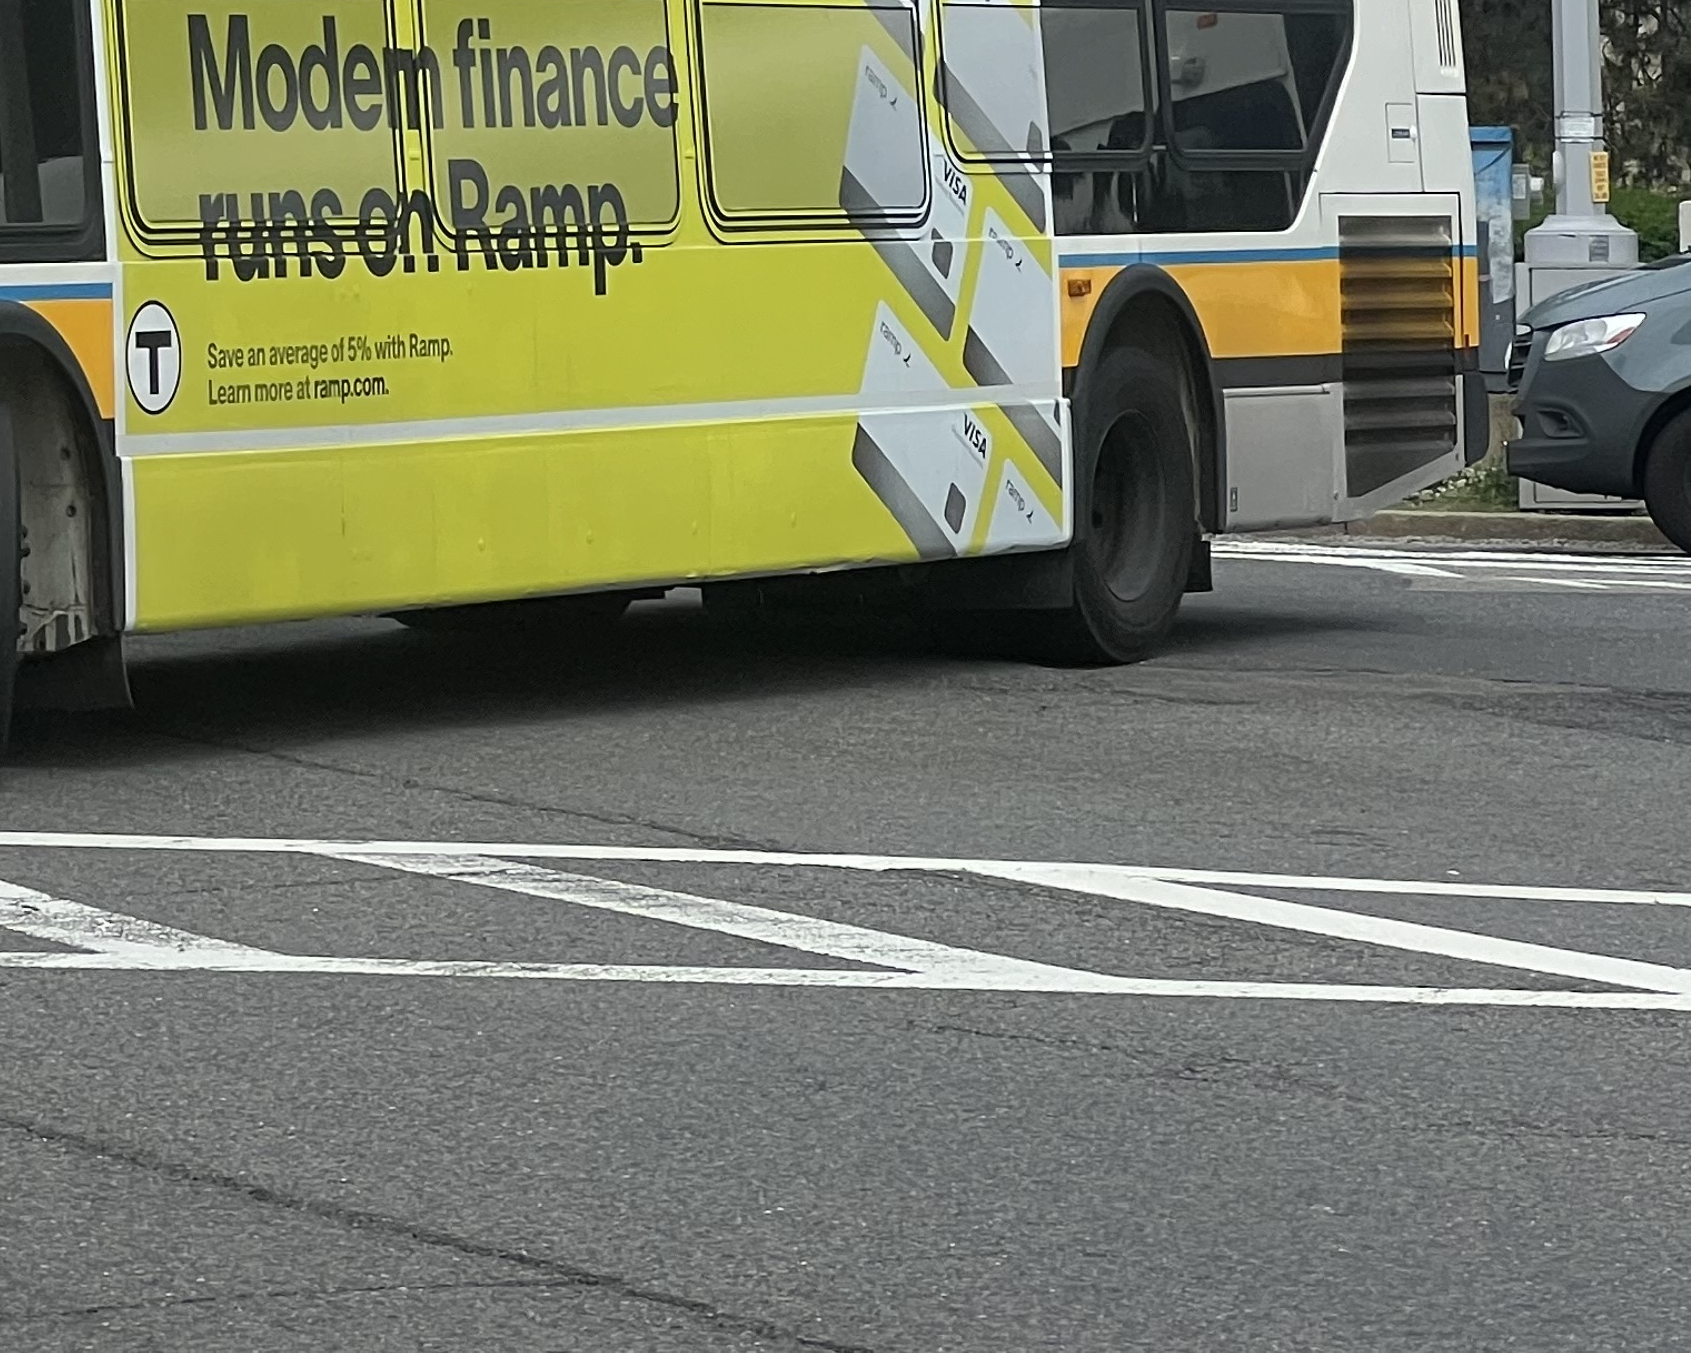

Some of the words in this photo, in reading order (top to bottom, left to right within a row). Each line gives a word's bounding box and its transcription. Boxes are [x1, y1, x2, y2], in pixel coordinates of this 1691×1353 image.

[187, 14, 443, 130] Modern
[453, 18, 679, 129] finance
[943, 158, 968, 206] VISA
[199, 188, 346, 282] runs
[358, 187, 440, 278] on
[448, 159, 642, 296] Ramp.
[207, 342, 244, 369] Save
[247, 347, 265, 366] an
[269, 344, 328, 370] average
[331, 337, 344, 362] of
[348, 335, 372, 362] 5%
[374, 334, 406, 360] with
[409, 333, 453, 363] Ramp.
[208, 379, 251, 405] Learn
[254, 381, 293, 402] more
[296, 375, 311, 400] at
[314, 376, 389, 405] ramp.com.
[964, 412, 987, 459] VISA
